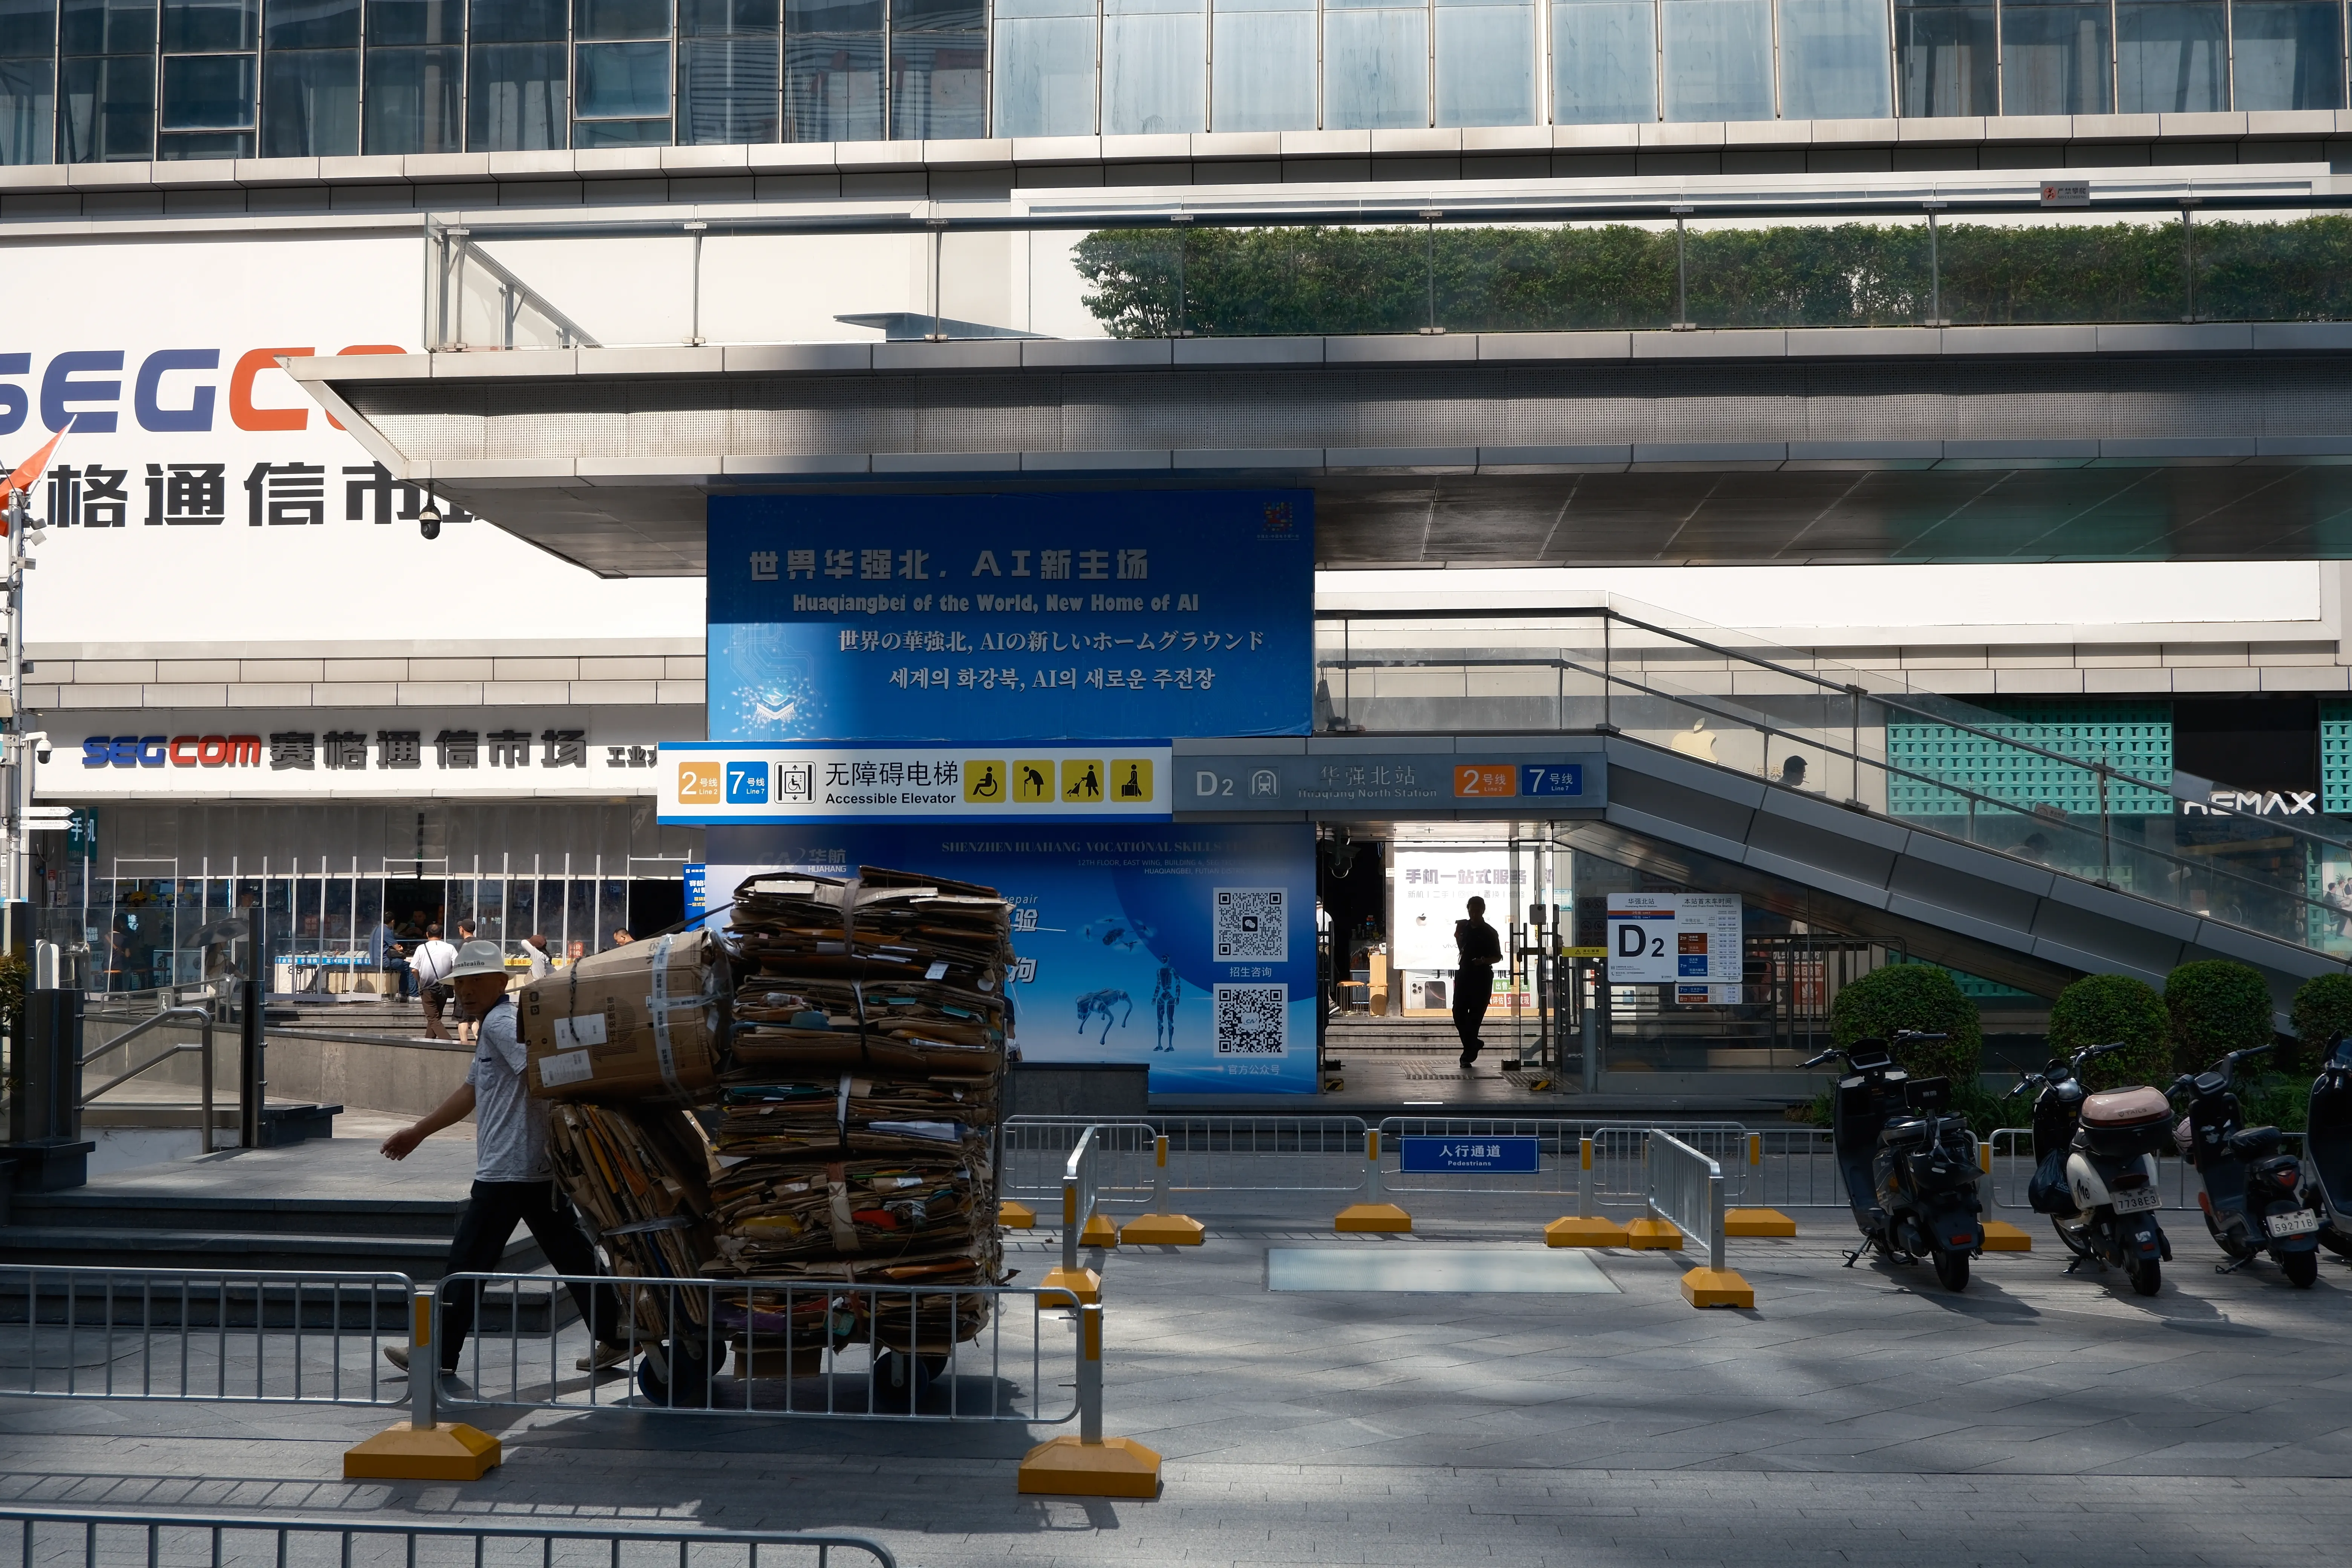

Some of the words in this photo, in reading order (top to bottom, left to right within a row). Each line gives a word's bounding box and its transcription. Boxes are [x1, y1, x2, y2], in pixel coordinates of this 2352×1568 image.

[793, 593, 905, 615] Huaqiangbei
[914, 593, 931, 611] of
[939, 593, 969, 611] the
[977, 593, 1039, 614] World,
[1046, 593, 1083, 611] New
[1091, 593, 1144, 611] Home
[1150, 593, 1171, 611] of
[1178, 593, 1199, 611] AI
[889, 667, 949, 691] 세계의
[956, 667, 1026, 692] 화강북,
[1032, 667, 1077, 691] AI의
[1084, 667, 1144, 691] 새로운
[1152, 667, 1215, 691] 주전장
[82, 735, 261, 766] SEGCOM
[270, 730, 587, 769] 赛格通信市场
[825, 761, 959, 787] 无障碍电梯
[1320, 764, 1415, 786] 华强北站
[825, 793, 897, 804] Accessible
[902, 793, 956, 804] Elevator
[1298, 789, 1354, 799] Huaqiang
[1358, 789, 1390, 798] North
[1395, 788, 1437, 798] Station
[942, 842, 1012, 852] SHENZHEN
[1015, 842, 1081, 852] HUAHANG
[1086, 842, 1171, 852] VOCATIONAL
[1174, 842, 1221, 852] SKILLS
[809, 849, 846, 864] 华航
[1406, 868, 1527, 884] 手机一站式服务
[1230, 966, 1272, 977] 招生咨询
[606, 996, 617, 1045] 十年免费包修
[1228, 1065, 1280, 1075] 官方公众号
[1439, 1145, 1501, 1158] 人行通道
[2118, 1196, 2156, 1209] 7738E3
[2275, 1219, 2313, 1232] 59271B
